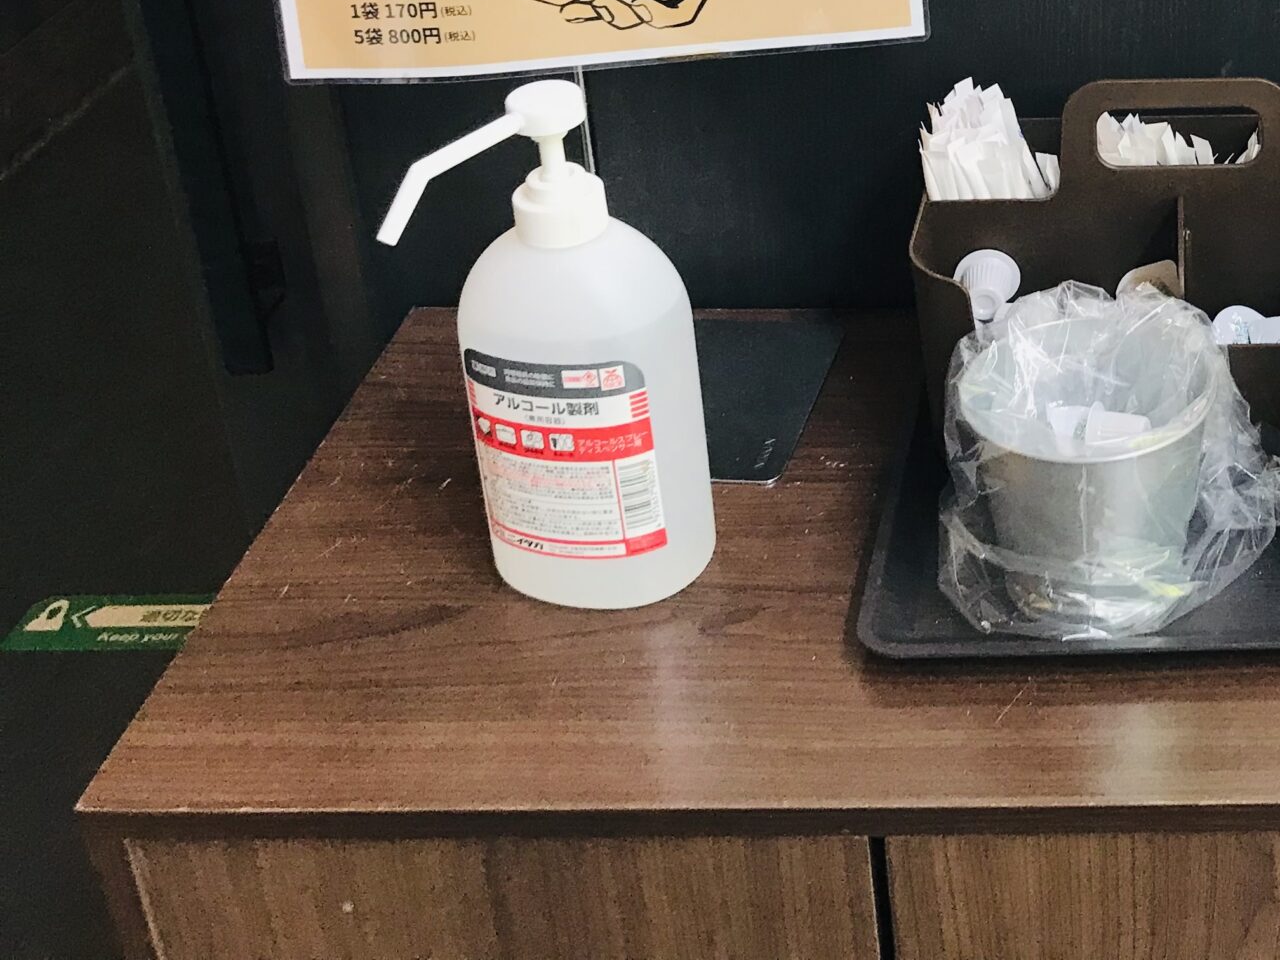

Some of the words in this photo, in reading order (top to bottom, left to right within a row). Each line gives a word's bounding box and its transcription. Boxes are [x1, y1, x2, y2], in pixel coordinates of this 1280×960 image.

[493, 392, 599, 417] アルコール製剤
[97, 632, 140, 643] Keep
